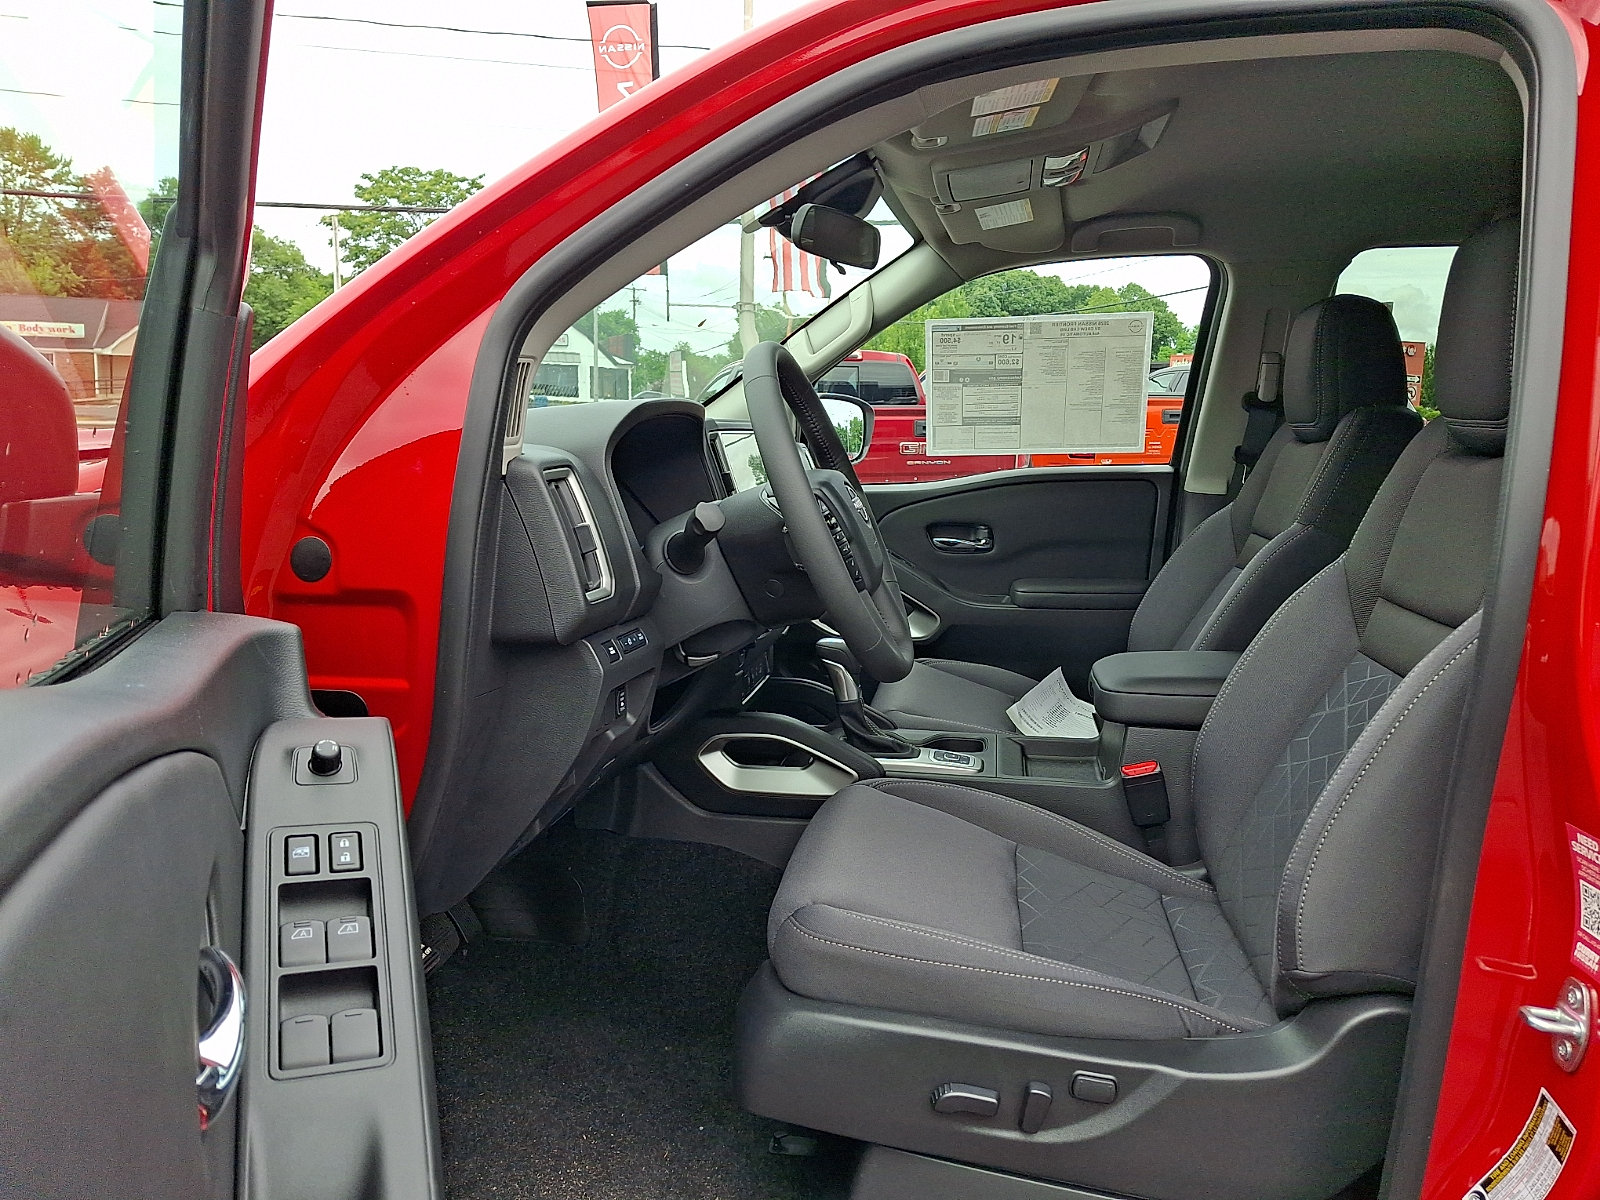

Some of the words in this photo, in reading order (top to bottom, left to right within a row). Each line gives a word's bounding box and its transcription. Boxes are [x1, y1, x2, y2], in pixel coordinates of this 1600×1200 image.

[18, 323, 44, 333] Body
[48, 325, 76, 334] work
[1571, 841, 1600, 865] SERVIC
[1500, 1158, 1510, 1171] AND
[1509, 1139, 1525, 1161] LOADING
